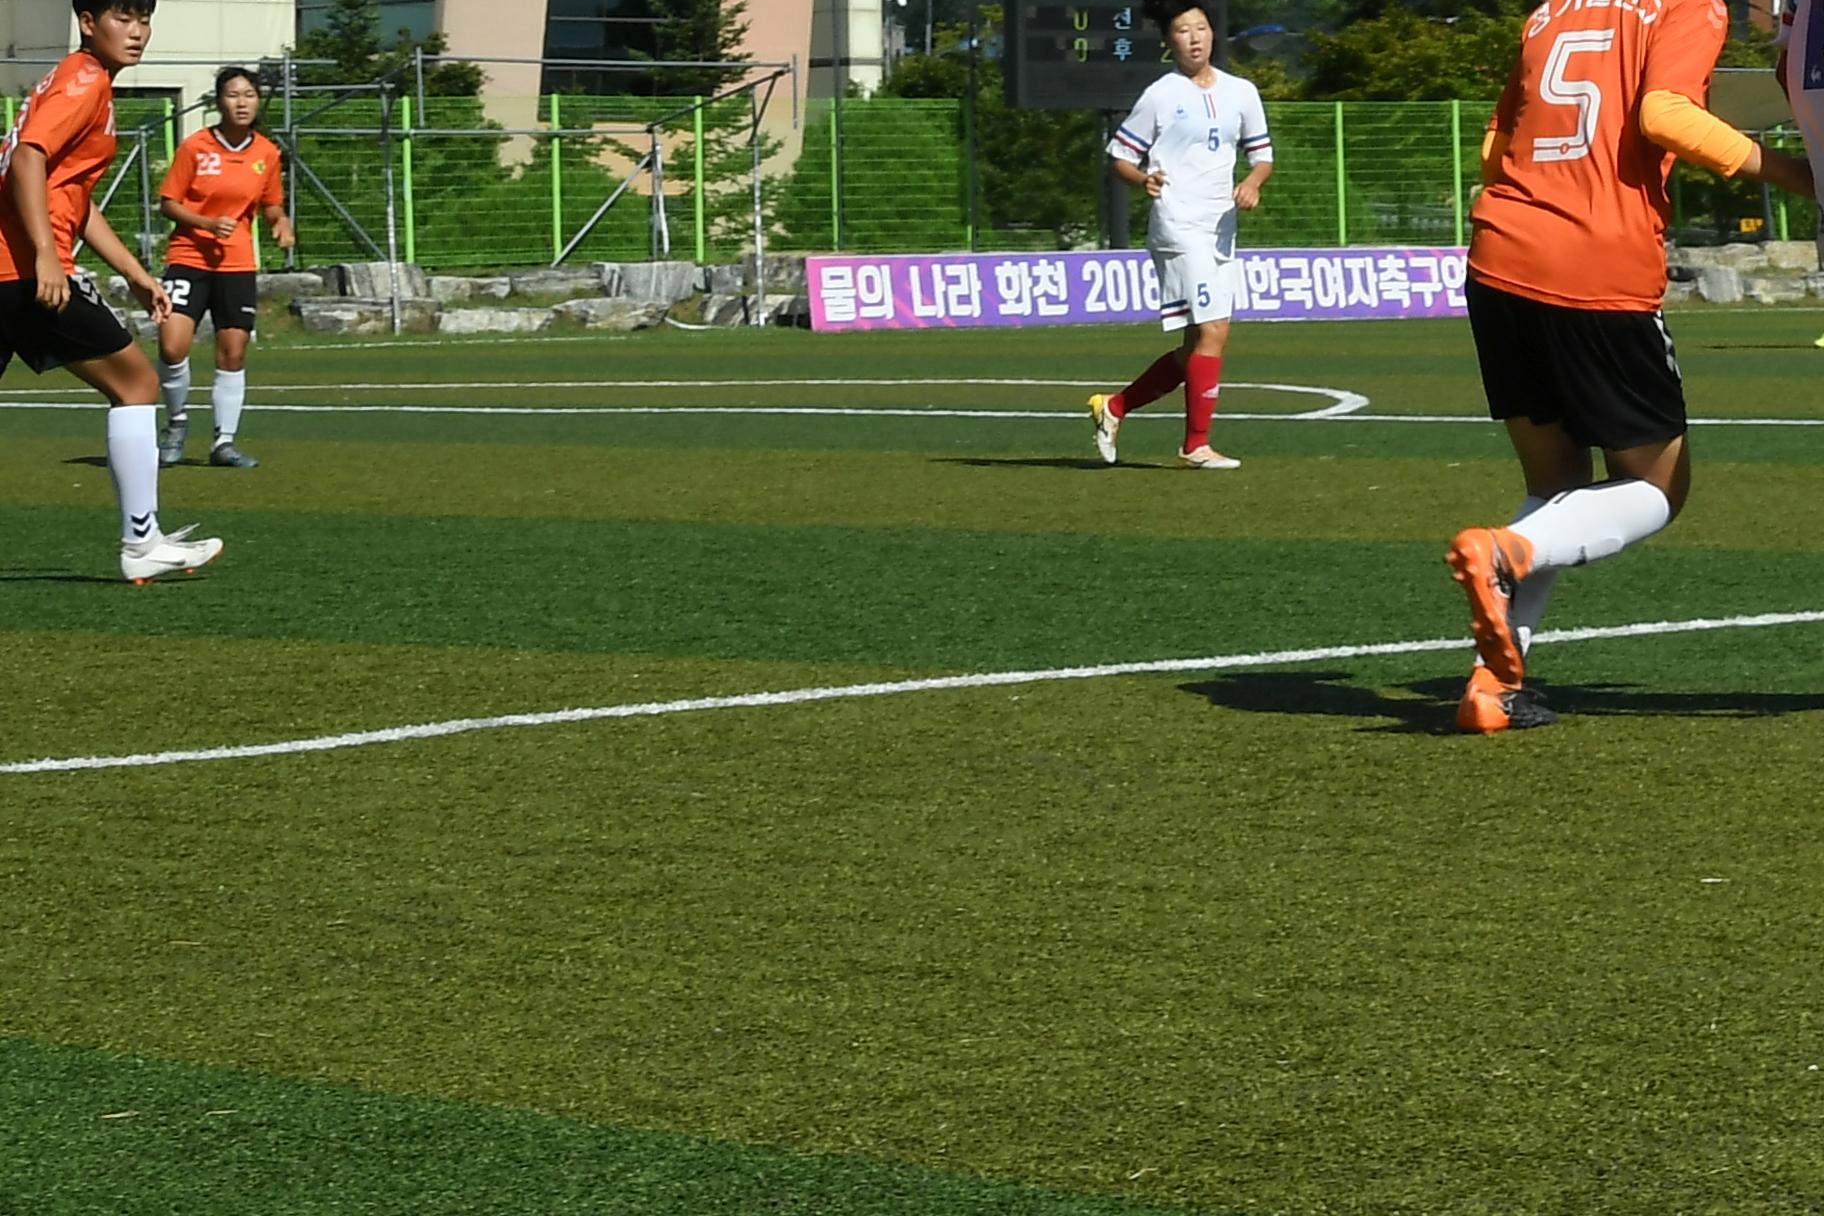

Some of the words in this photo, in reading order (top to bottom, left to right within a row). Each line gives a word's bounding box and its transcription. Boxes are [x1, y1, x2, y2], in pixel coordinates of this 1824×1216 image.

[1112, 37, 1133, 61] 후
[1532, 27, 1616, 163] 5
[1207, 127, 1220, 151] 5
[196, 152, 223, 176] 22
[820, 264, 895, 322] 물의
[908, 262, 982, 319] 나라
[994, 258, 1070, 317] 화천
[1081, 259, 1160, 313] 2018
[1196, 282, 1210, 308] 5
